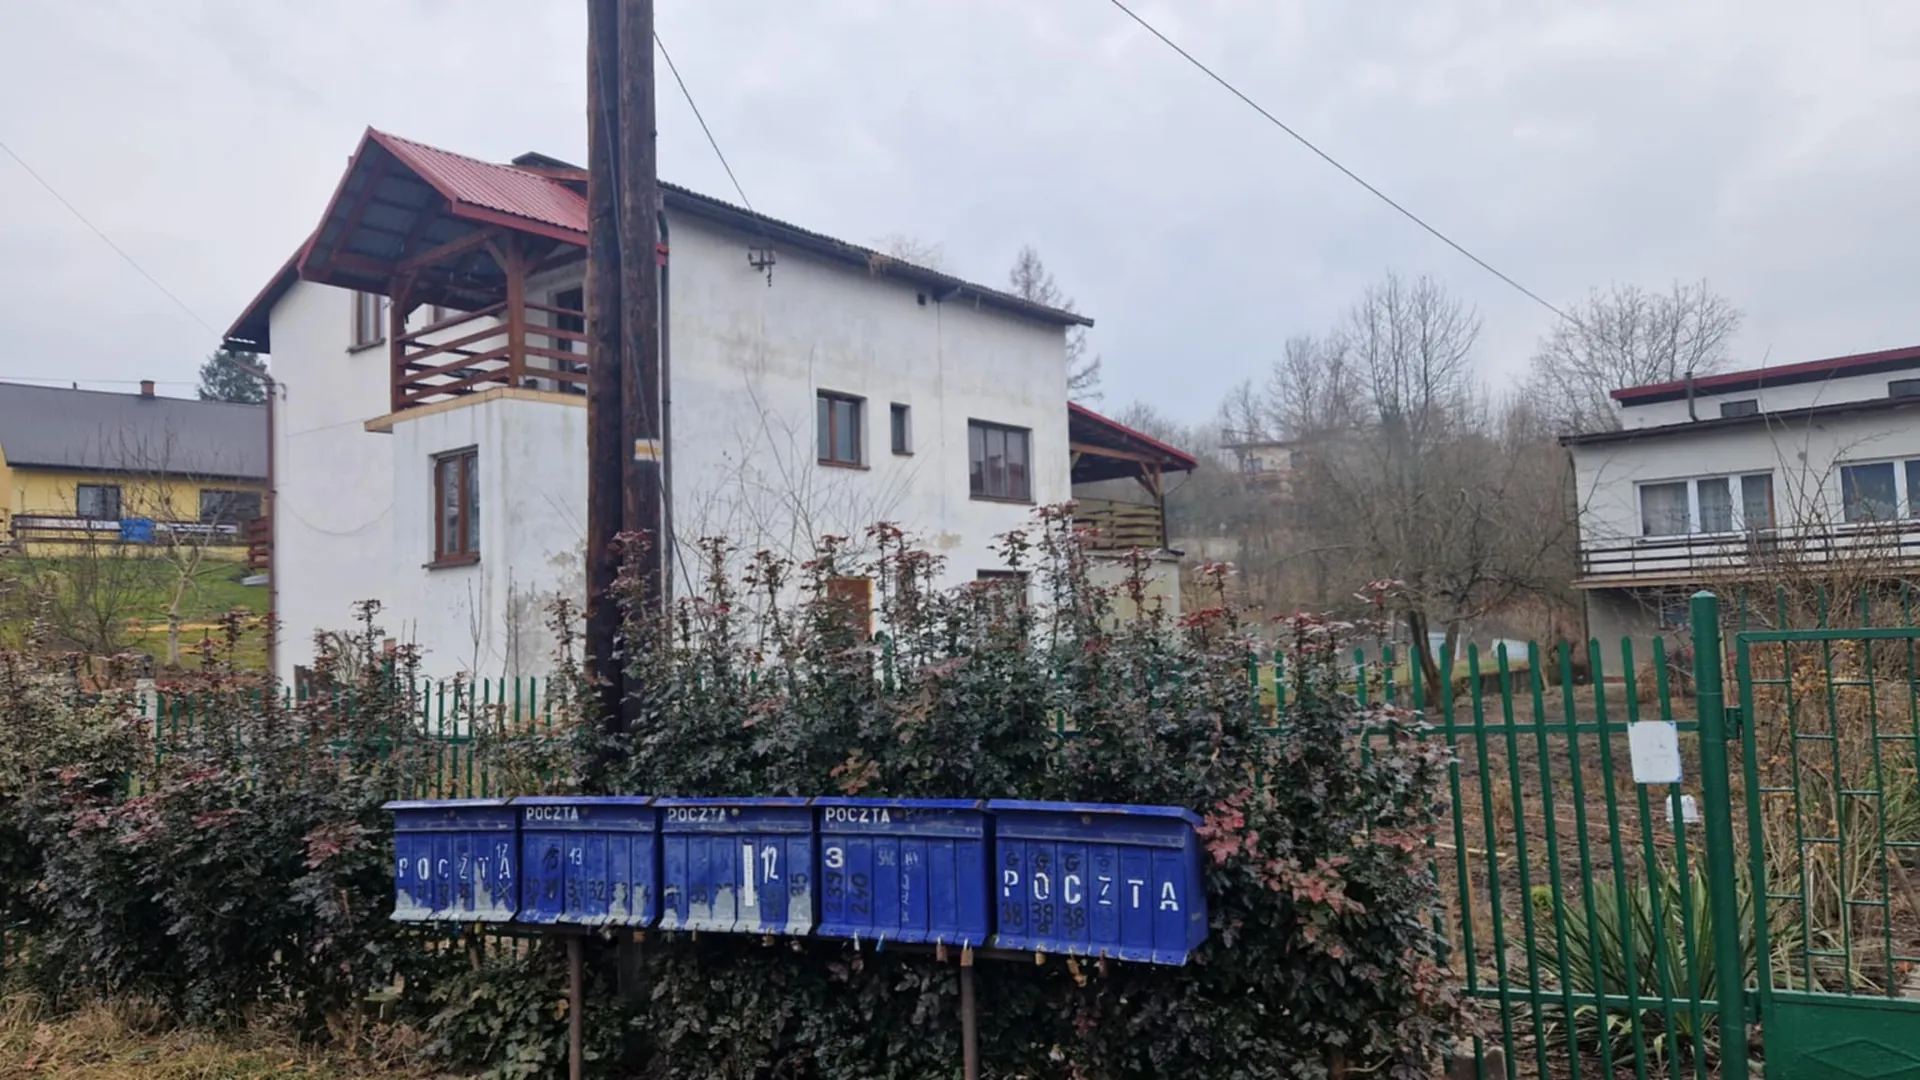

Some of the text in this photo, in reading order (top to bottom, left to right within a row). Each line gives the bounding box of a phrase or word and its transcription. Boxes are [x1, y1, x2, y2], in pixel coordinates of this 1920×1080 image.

[526, 806, 579, 820] POCZTA
[667, 807, 726, 822] POCZTA
[825, 807, 891, 824] POCZTA
[569, 847, 583, 865] 13
[761, 845, 779, 884] 12
[825, 846, 844, 869] 3
[1004, 869, 1179, 912] POCZTA
